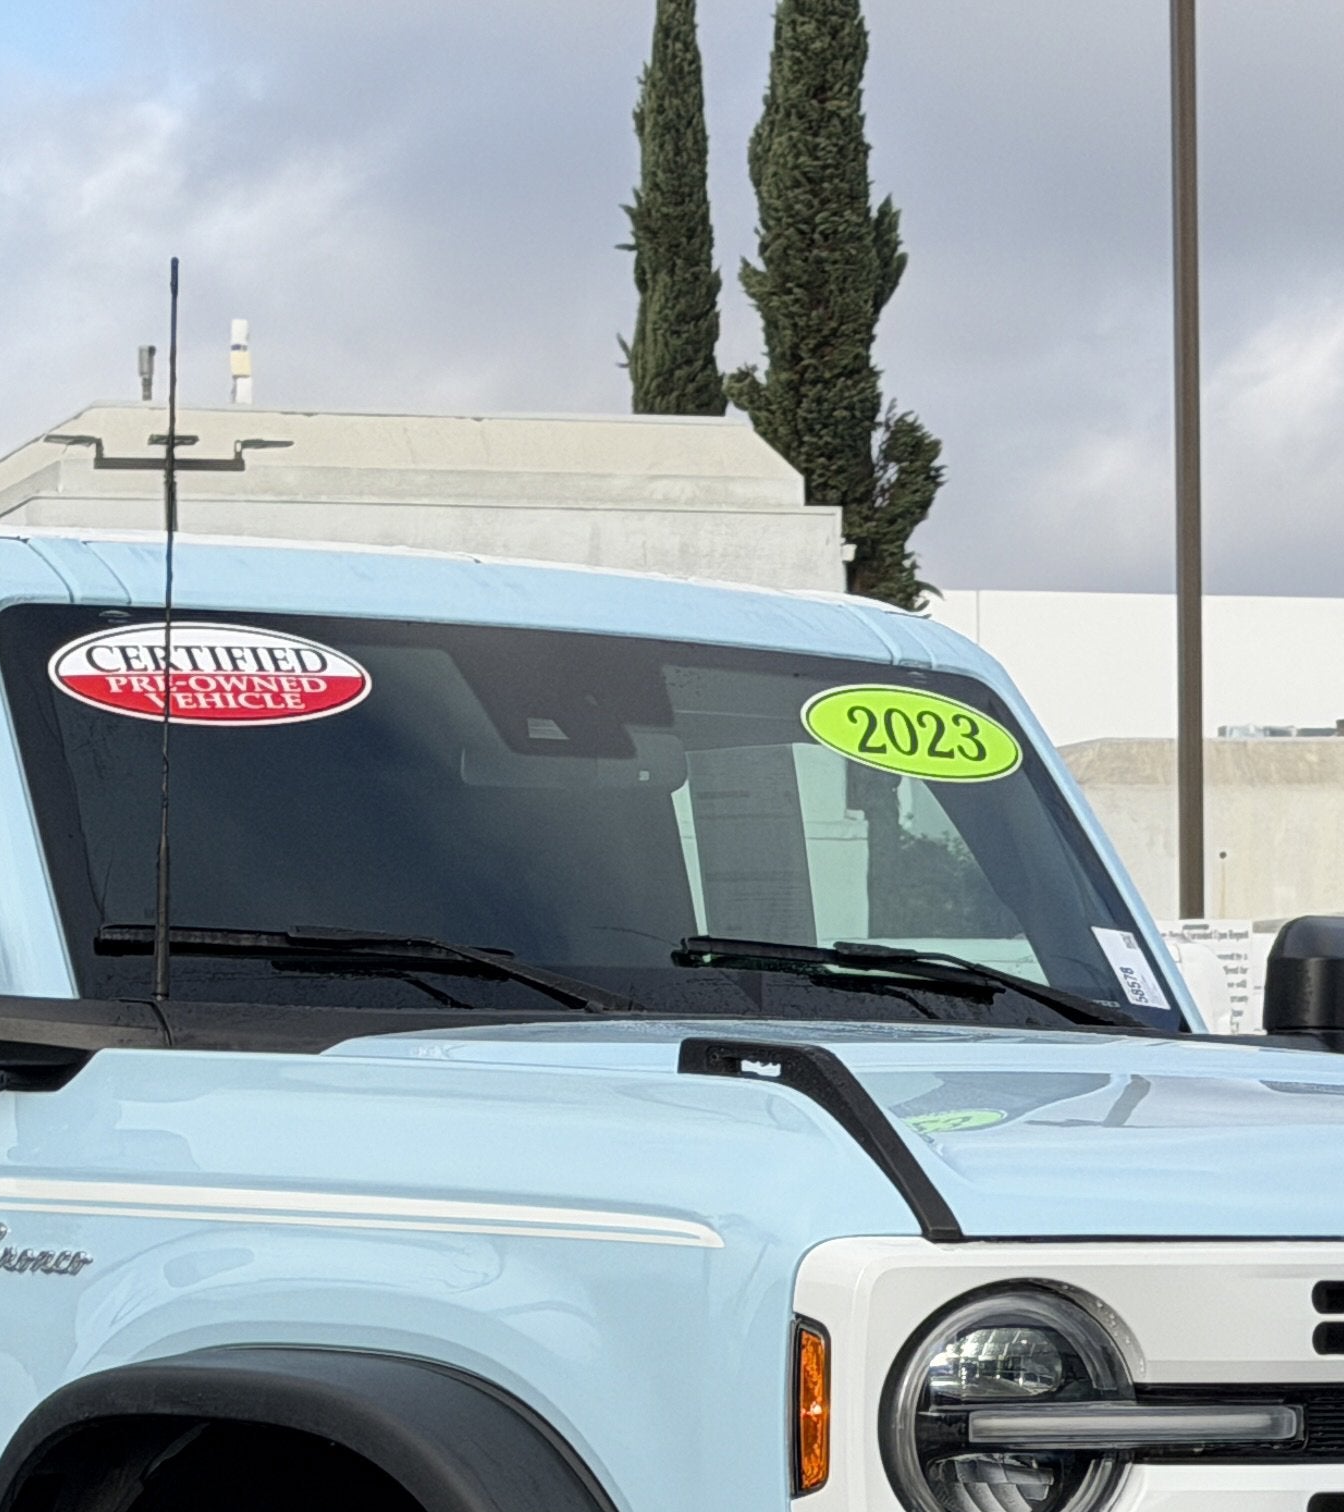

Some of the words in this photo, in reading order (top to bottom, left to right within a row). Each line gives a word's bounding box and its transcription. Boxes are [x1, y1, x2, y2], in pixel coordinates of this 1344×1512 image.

[85, 645, 328, 673] CERTIFIED
[107, 674, 327, 694] PRE-OWNED
[145, 691, 306, 710] VEHICLE
[846, 705, 988, 762] 2023
[1119, 966, 1149, 1004] 58578
